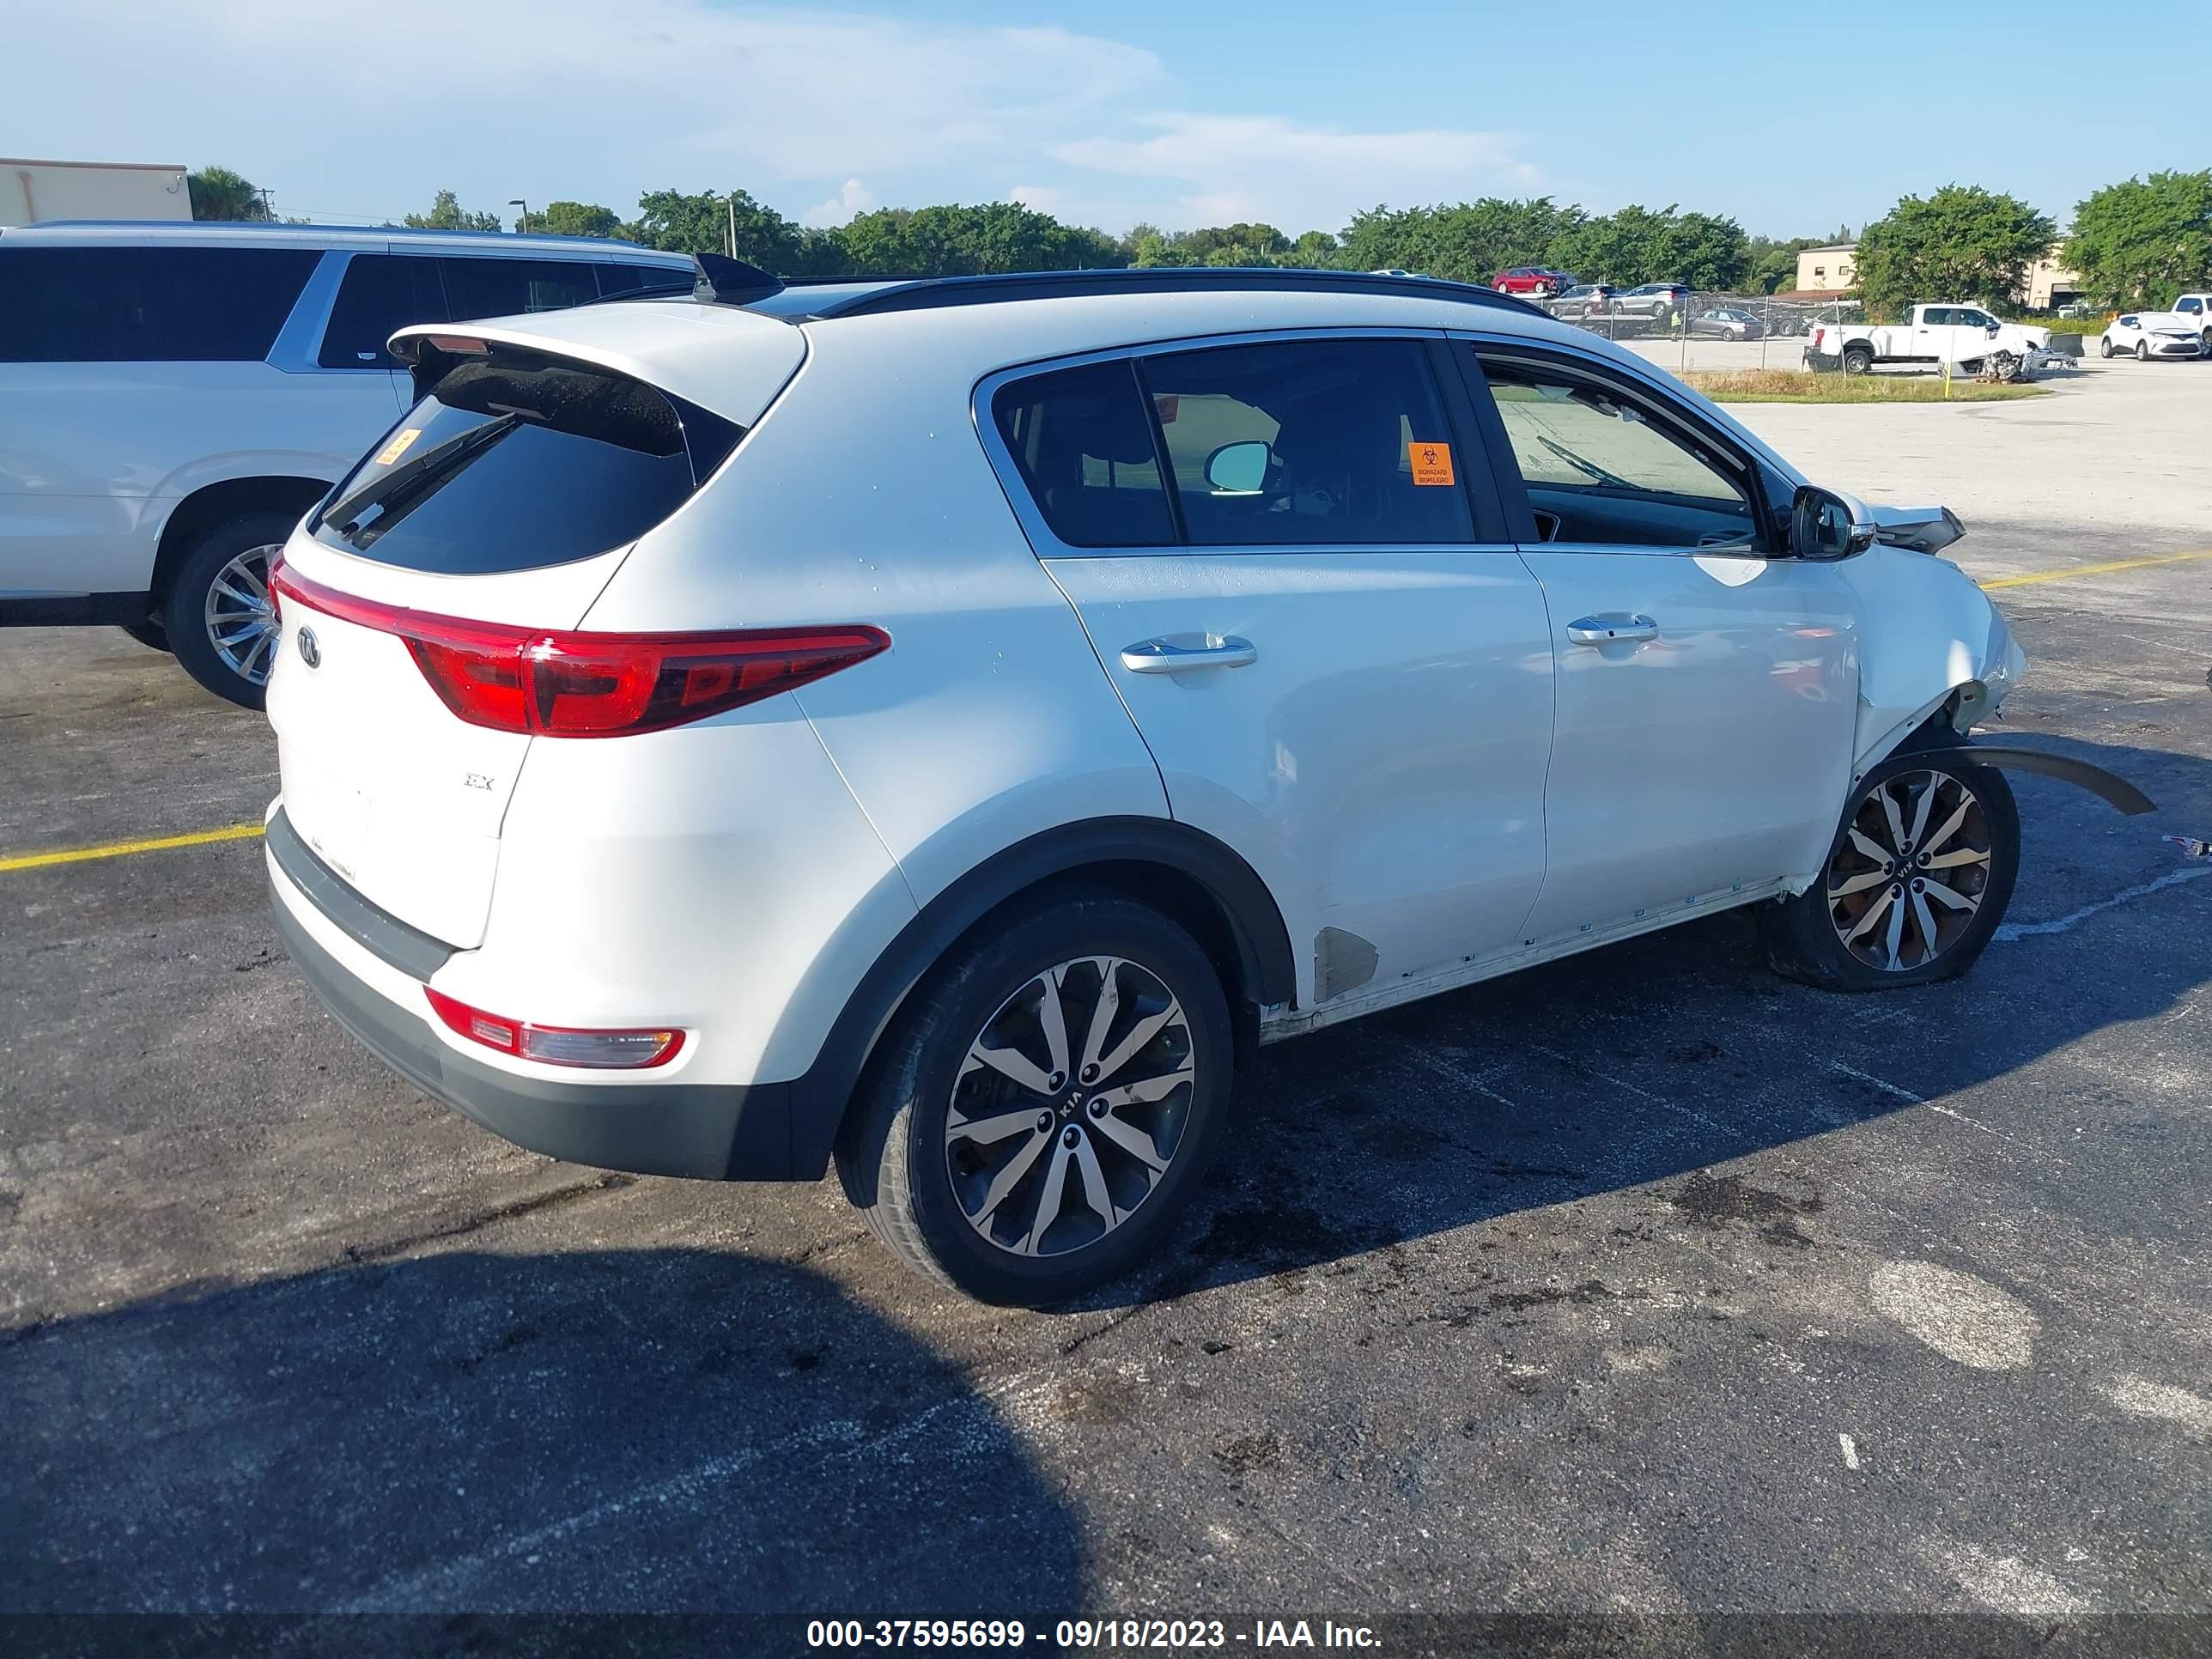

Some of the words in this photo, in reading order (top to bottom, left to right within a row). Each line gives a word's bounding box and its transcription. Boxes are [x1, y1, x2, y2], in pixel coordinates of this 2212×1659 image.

[464, 773, 495, 791] EX
[1898, 861, 1913, 878] KIA
[1060, 1091, 1082, 1117] KIA
